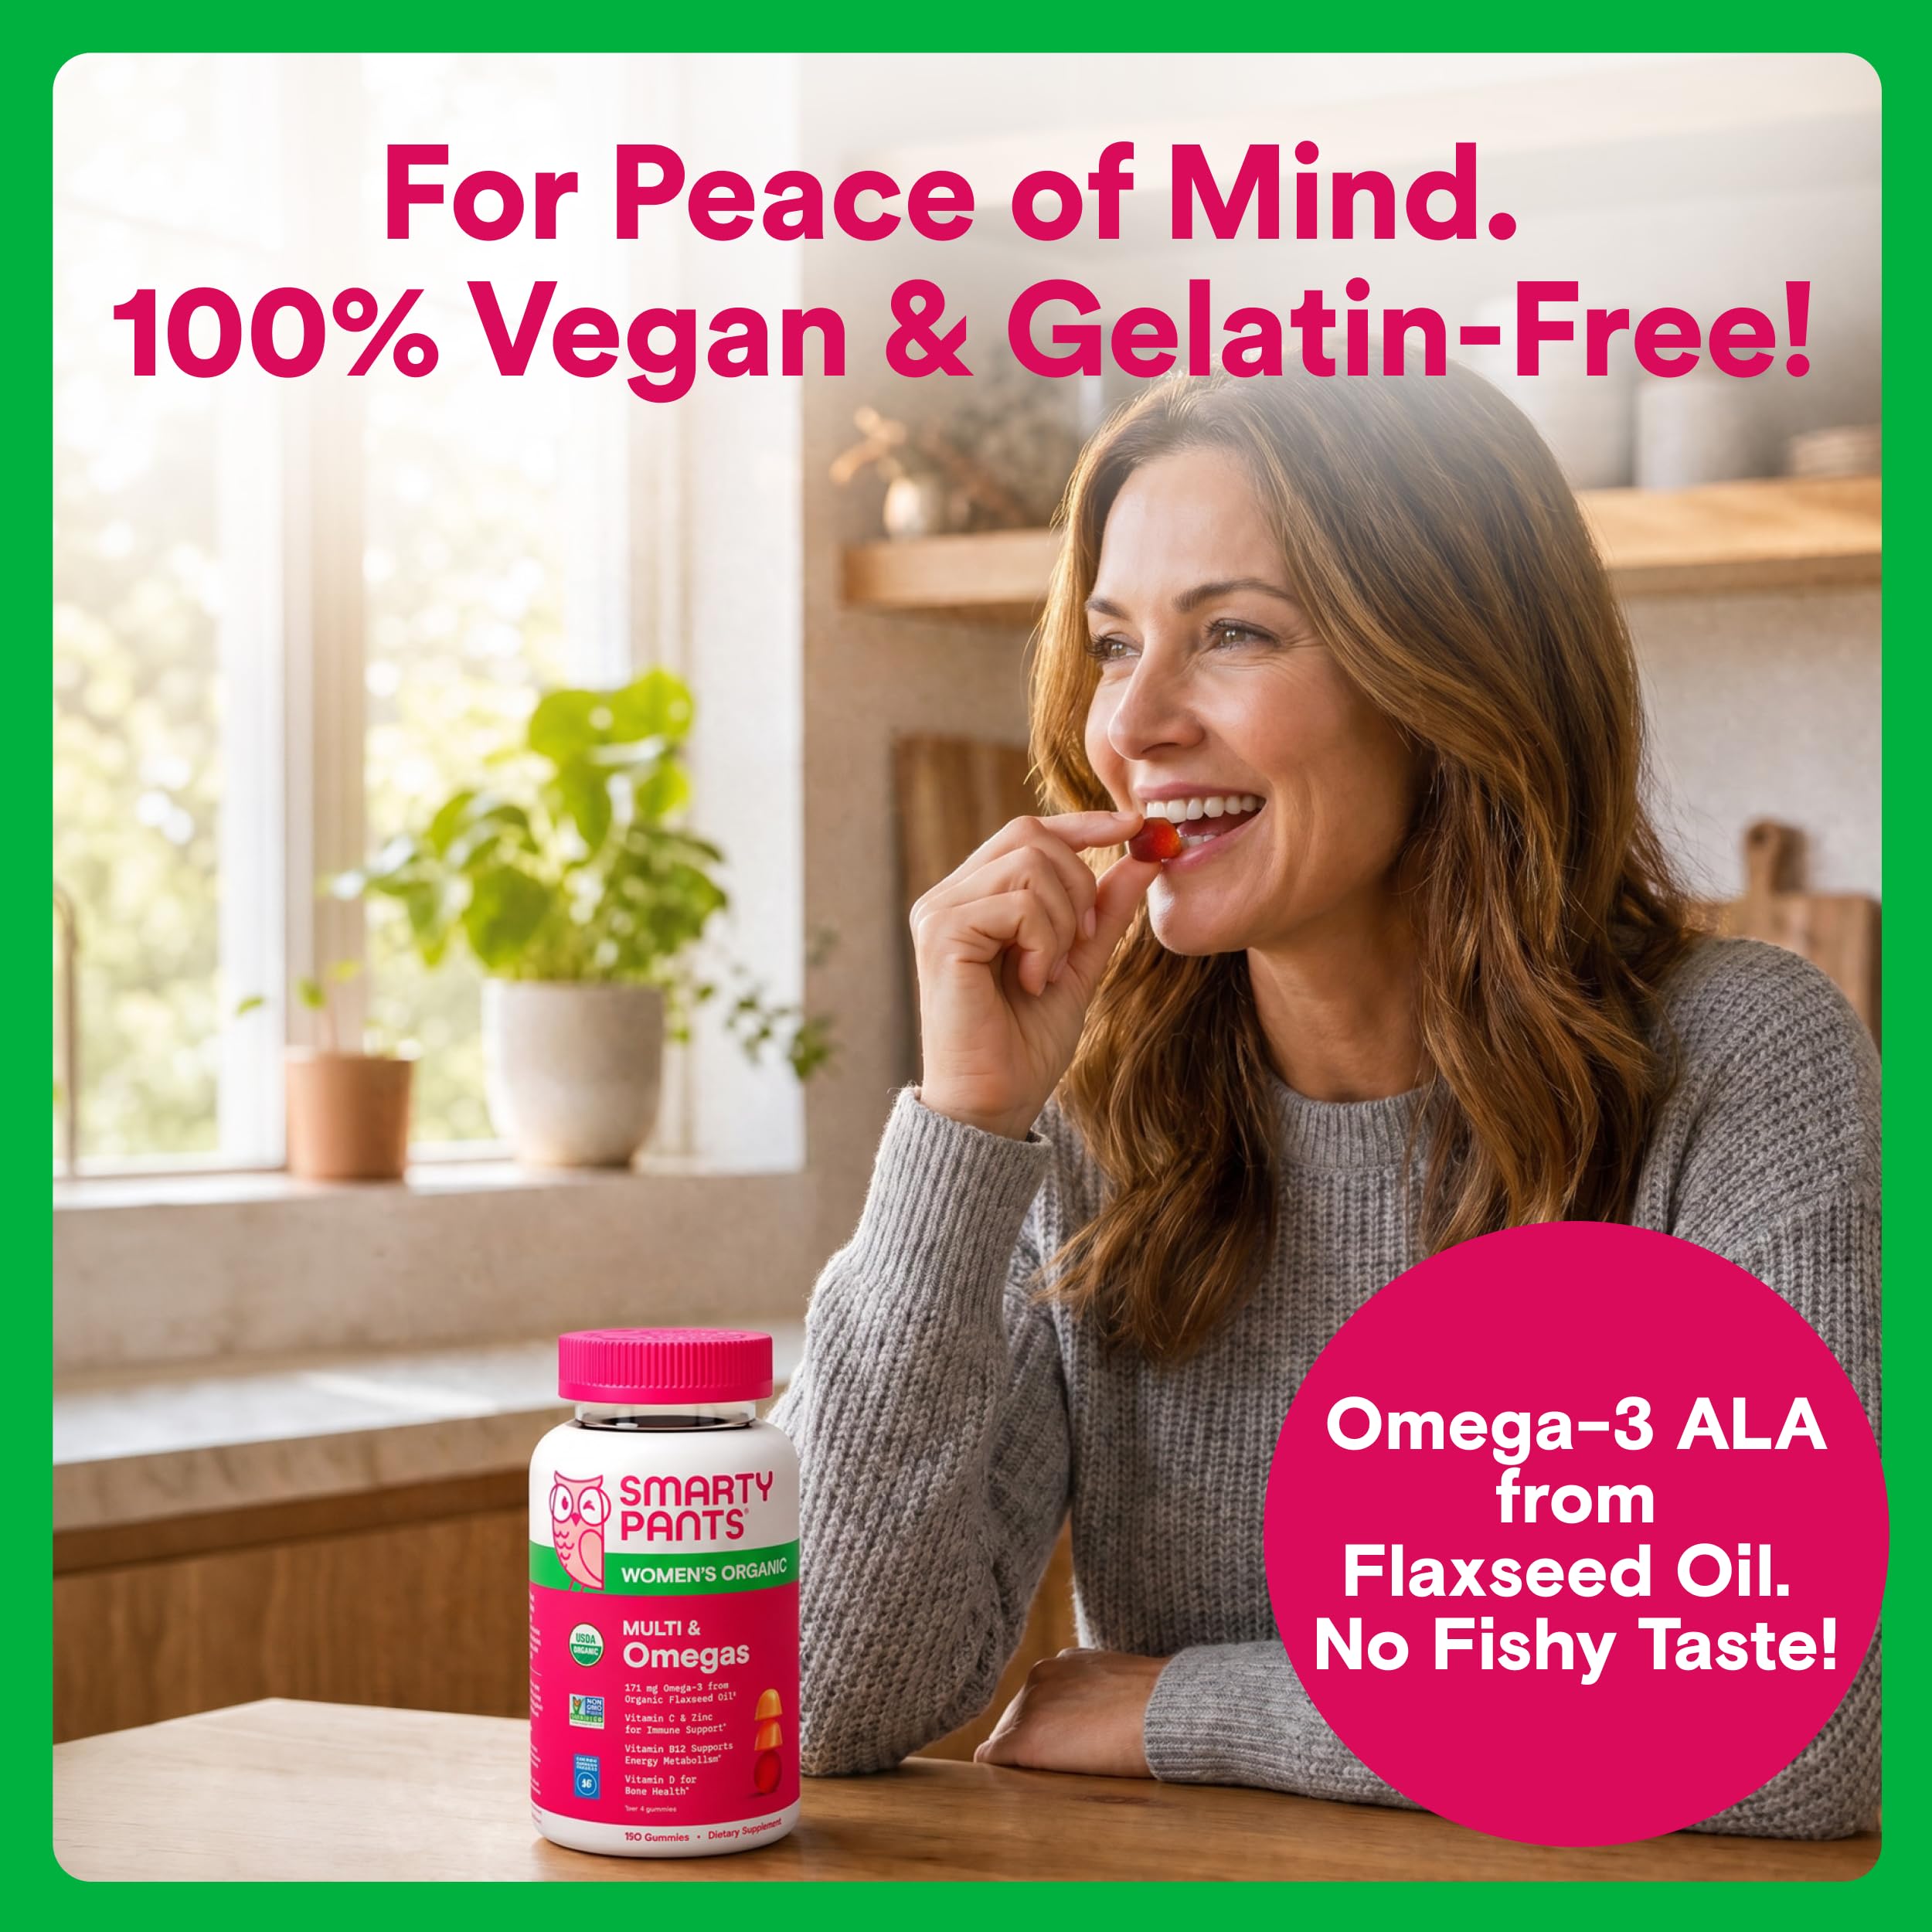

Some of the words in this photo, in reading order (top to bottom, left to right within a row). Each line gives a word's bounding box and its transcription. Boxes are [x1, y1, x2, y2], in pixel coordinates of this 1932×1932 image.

[620, 1471, 773, 1507] SMARTY
[621, 1564, 716, 1583] WOMEN’S
[721, 1557, 787, 1582] ORGANIC
[623, 1621, 682, 1636] MULTI
[688, 1620, 701, 1636] &
[576, 1632, 596, 1645] USDA
[573, 1645, 599, 1656] ORGANIC
[623, 1641, 750, 1674] Omegas
[624, 1683, 641, 1692] 171
[646, 1685, 658, 1695] mg
[663, 1683, 703, 1695] Omega-3
[708, 1682, 729, 1691] from
[624, 1695, 663, 1706] Organic
[669, 1694, 713, 1704] Flaxseed
[624, 1713, 664, 1723] Vitamin
[668, 1714, 675, 1723] C
[692, 1713, 713, 1722] Zinc
[625, 1724, 642, 1734] for
[647, 1726, 680, 1734] Immune
[624, 1743, 664, 1753] Vitamin
[669, 1745, 686, 1753] B12
[691, 1743, 733, 1754] Supports
[624, 1756, 658, 1767] Energy
[624, 1774, 664, 1784] Vitamin
[680, 1774, 696, 1784] for
[624, 1787, 647, 1795] Bone
[645, 1832, 690, 1842] Gummies
[708, 1829, 740, 1839] Dietary
[742, 1818, 782, 1835] Supplement
